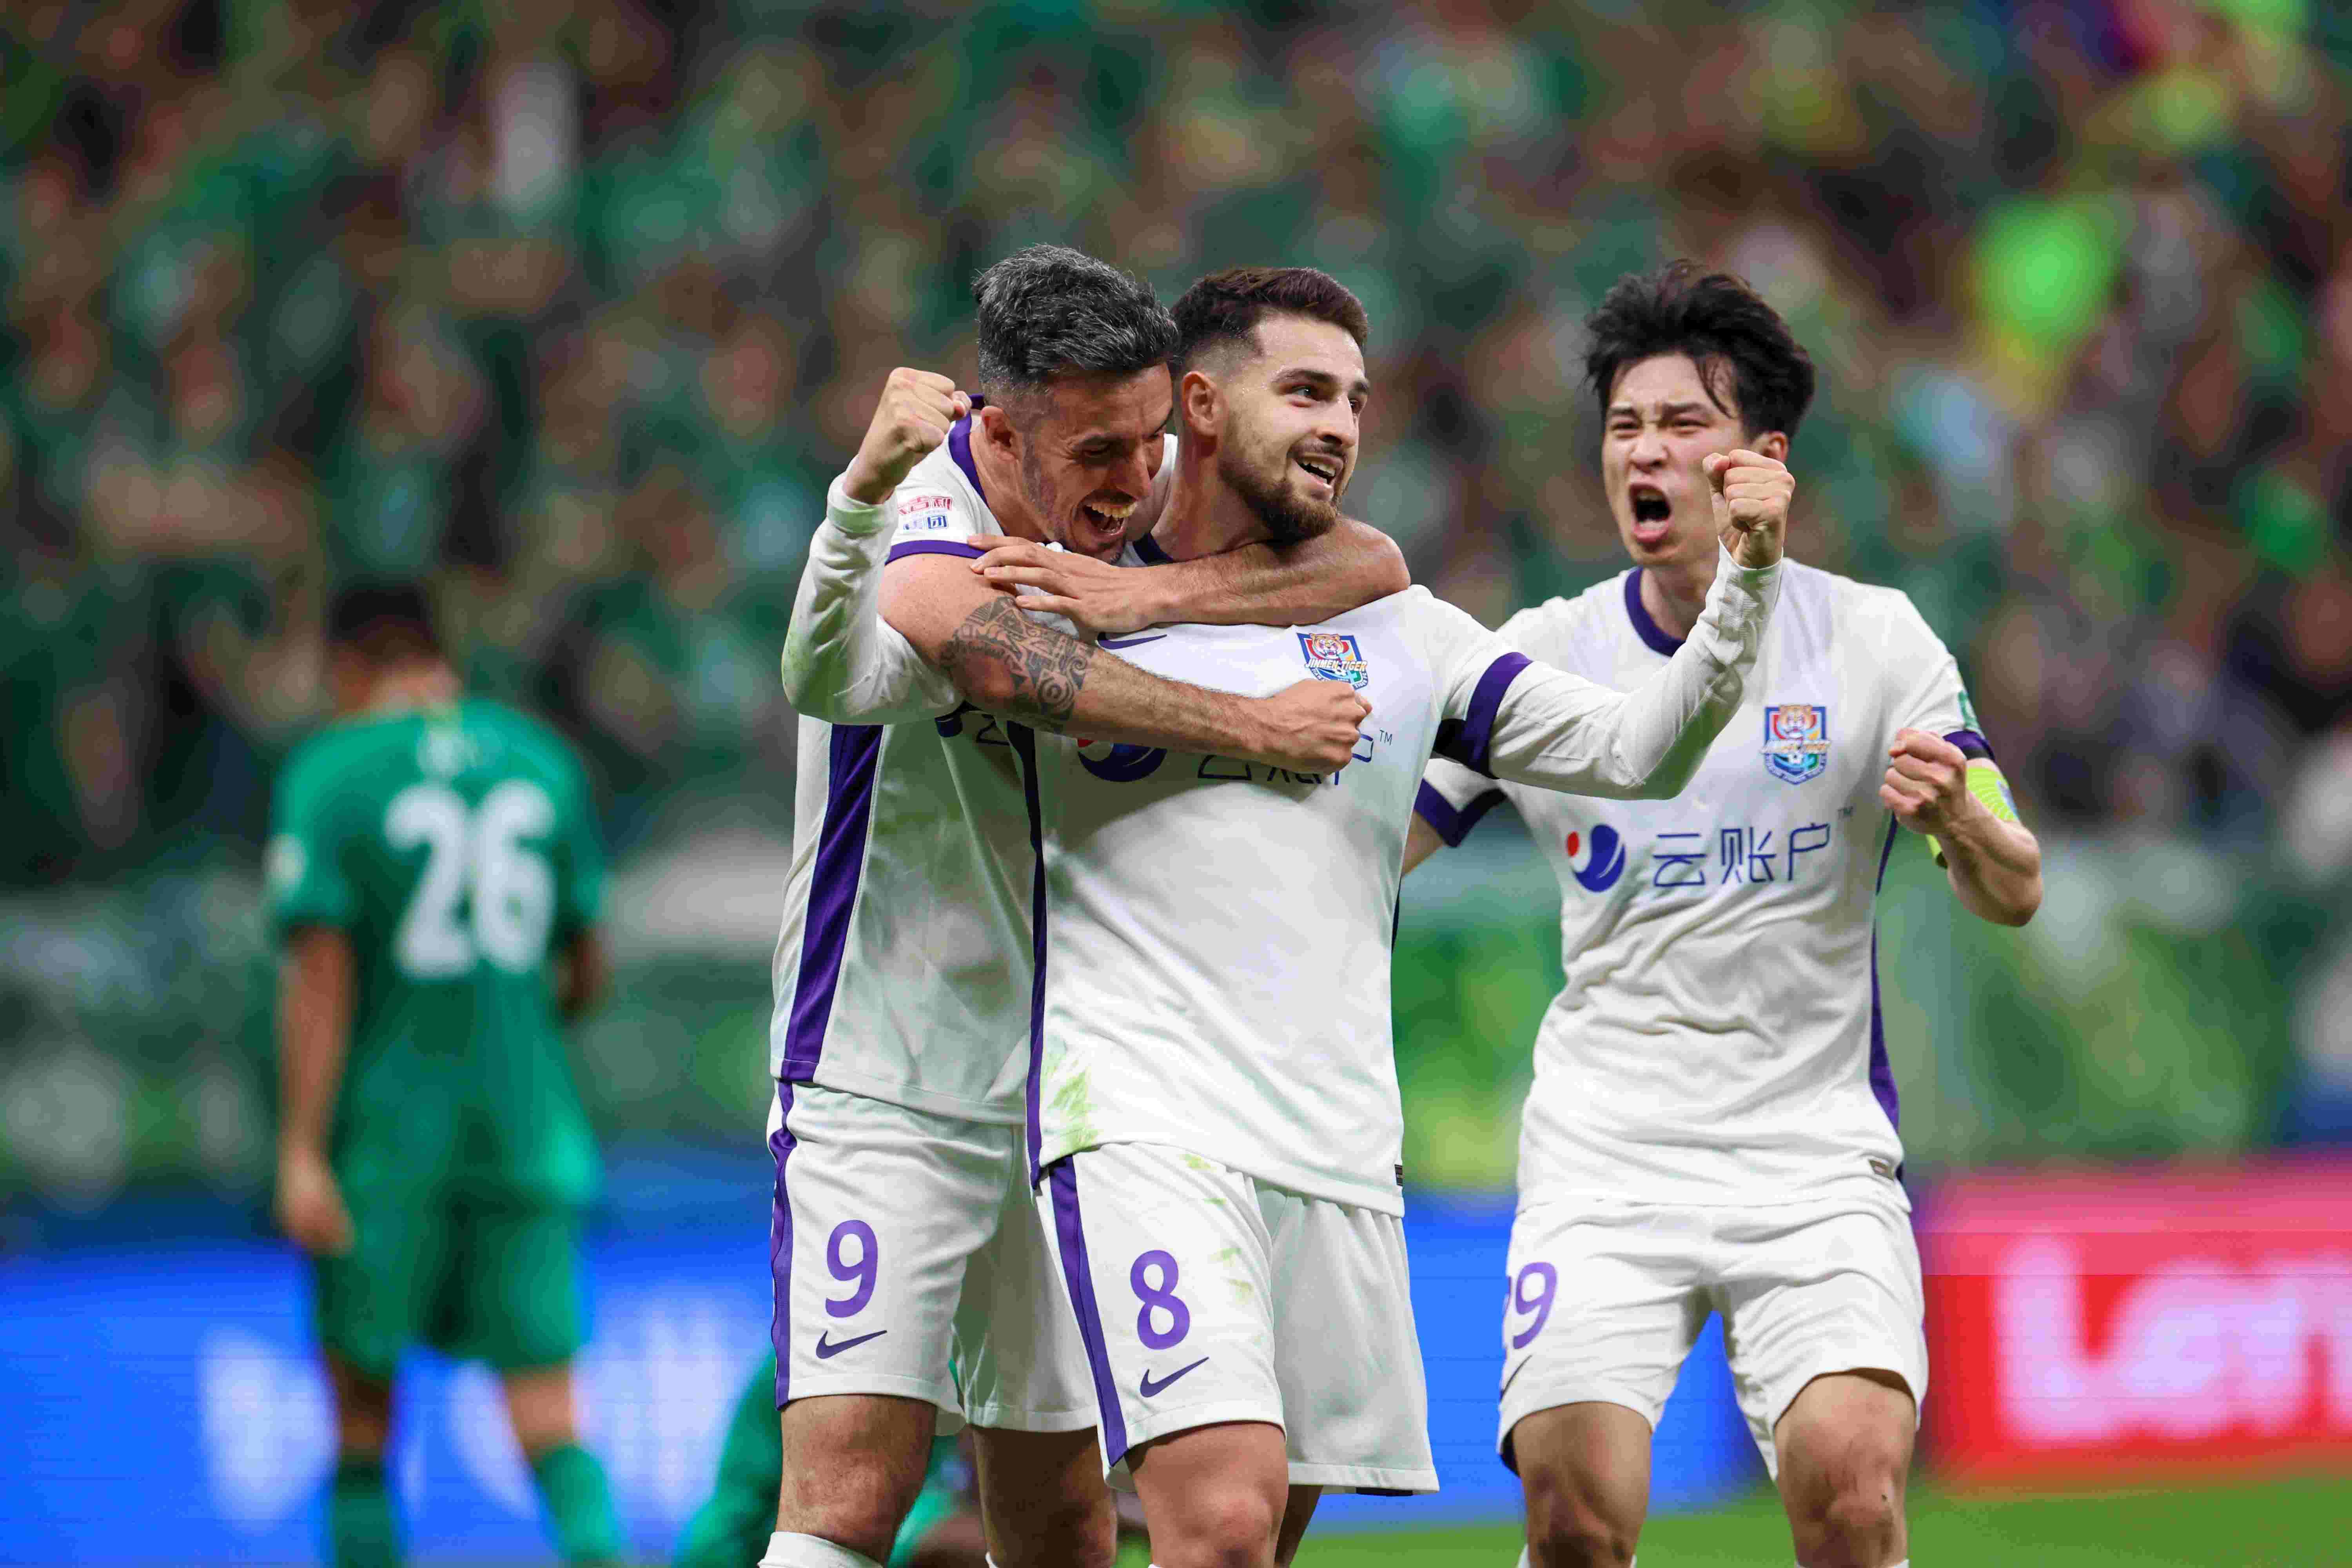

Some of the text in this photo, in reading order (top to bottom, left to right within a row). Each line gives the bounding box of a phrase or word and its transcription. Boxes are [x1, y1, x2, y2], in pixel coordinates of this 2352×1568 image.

[1305, 659, 1368, 671] JINMEN TIGER
[1379, 730, 1393, 746] TM
[386, 782, 554, 977] 26
[1652, 823, 1831, 888] 云账户
[825, 1220, 879, 1318] 9
[1129, 1249, 1190, 1350] 8
[1508, 1261, 1557, 1349] 9
